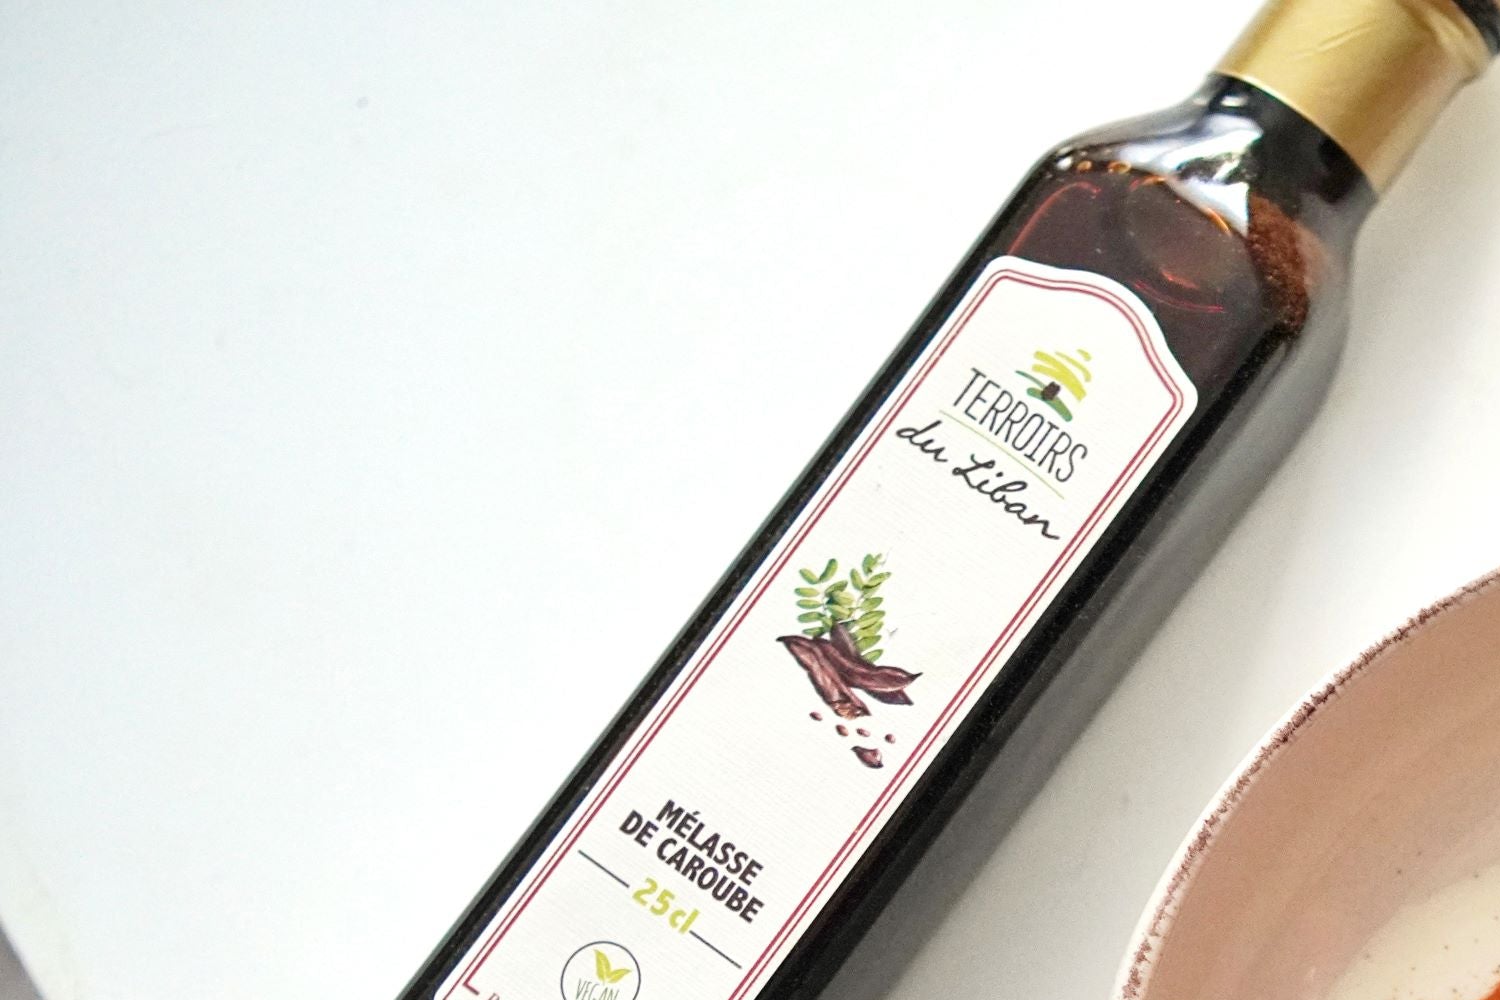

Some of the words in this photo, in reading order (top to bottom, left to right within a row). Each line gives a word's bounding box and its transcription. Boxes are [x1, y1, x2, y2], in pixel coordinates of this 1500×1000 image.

[896, 420, 948, 463] du
[952, 454, 1060, 540] Liban
[954, 367, 1088, 482] TERROIRS
[619, 809, 659, 847] DE
[656, 838, 765, 923] CAROUBE
[655, 799, 764, 886] MÉLASSE
